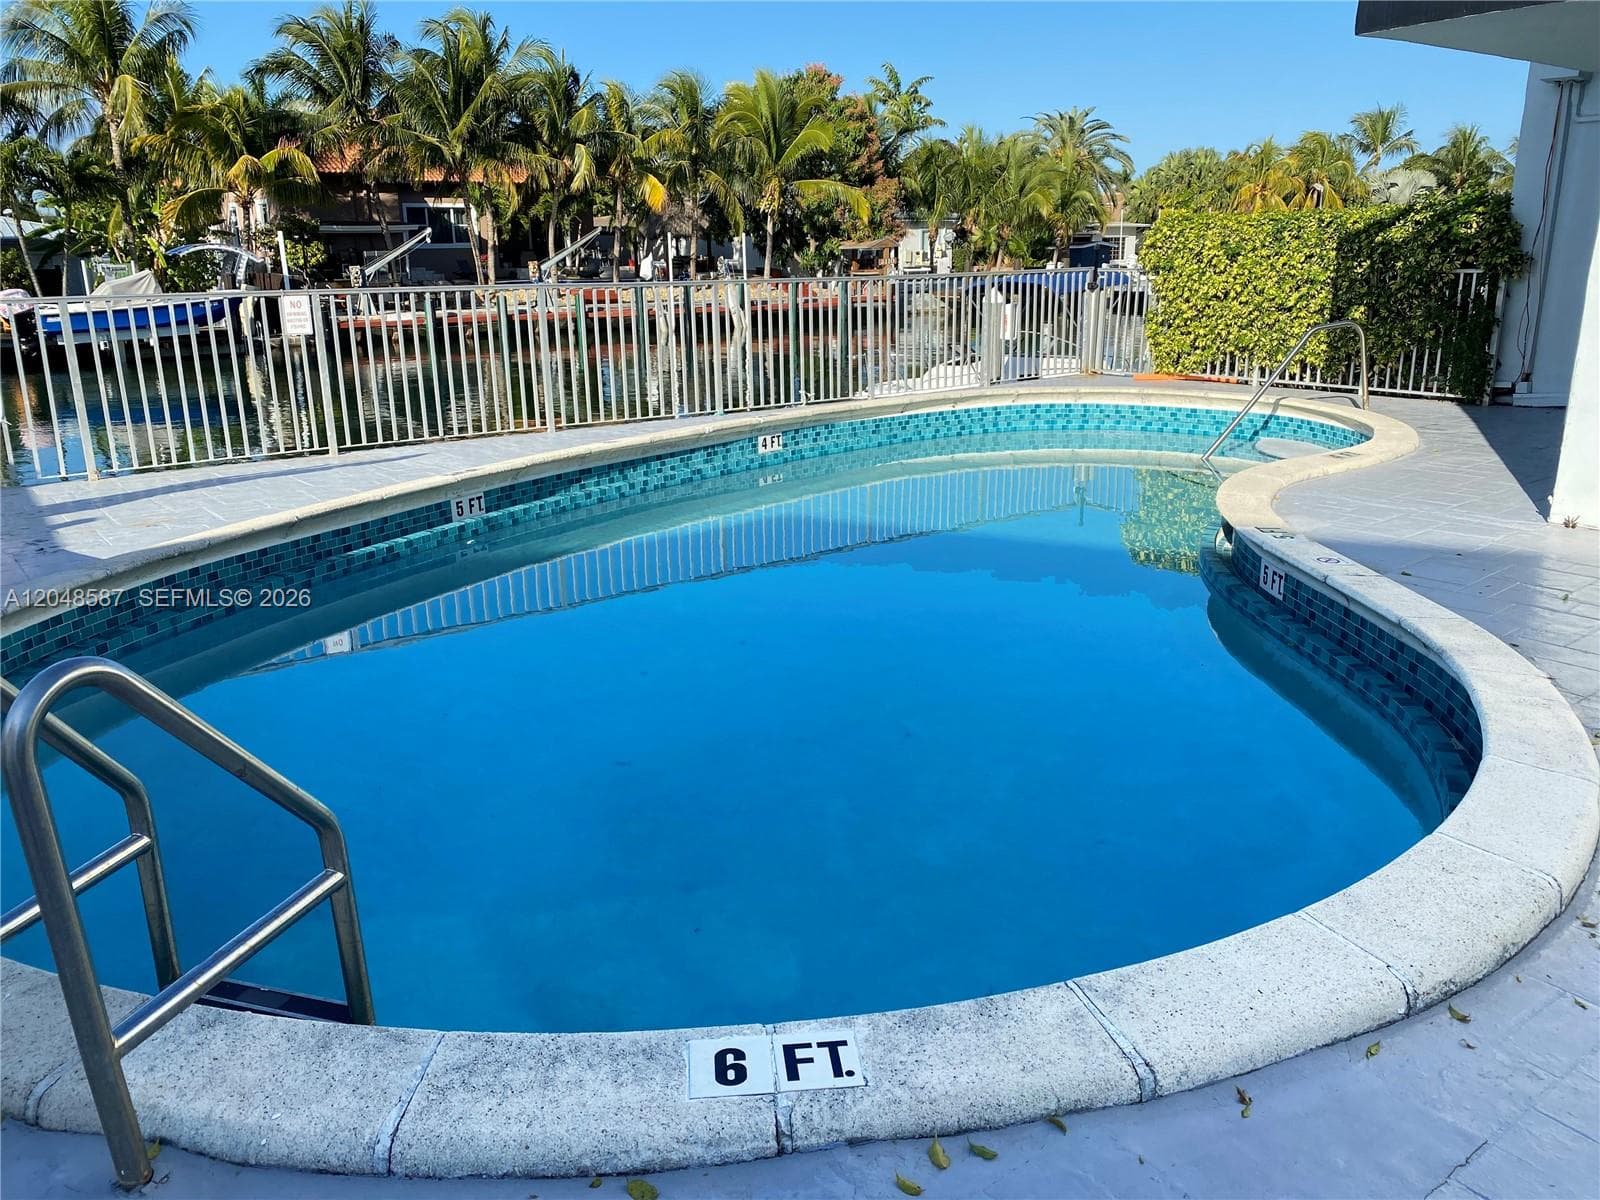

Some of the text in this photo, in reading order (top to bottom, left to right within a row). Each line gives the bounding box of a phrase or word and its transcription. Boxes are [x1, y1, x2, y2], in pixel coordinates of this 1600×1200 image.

[290, 300, 302, 309] NO
[761, 437, 768, 450] 4
[455, 495, 485, 517] 5 FT.
[1262, 564, 1269, 586] 5
[714, 1039, 856, 1087] 6 FT.
